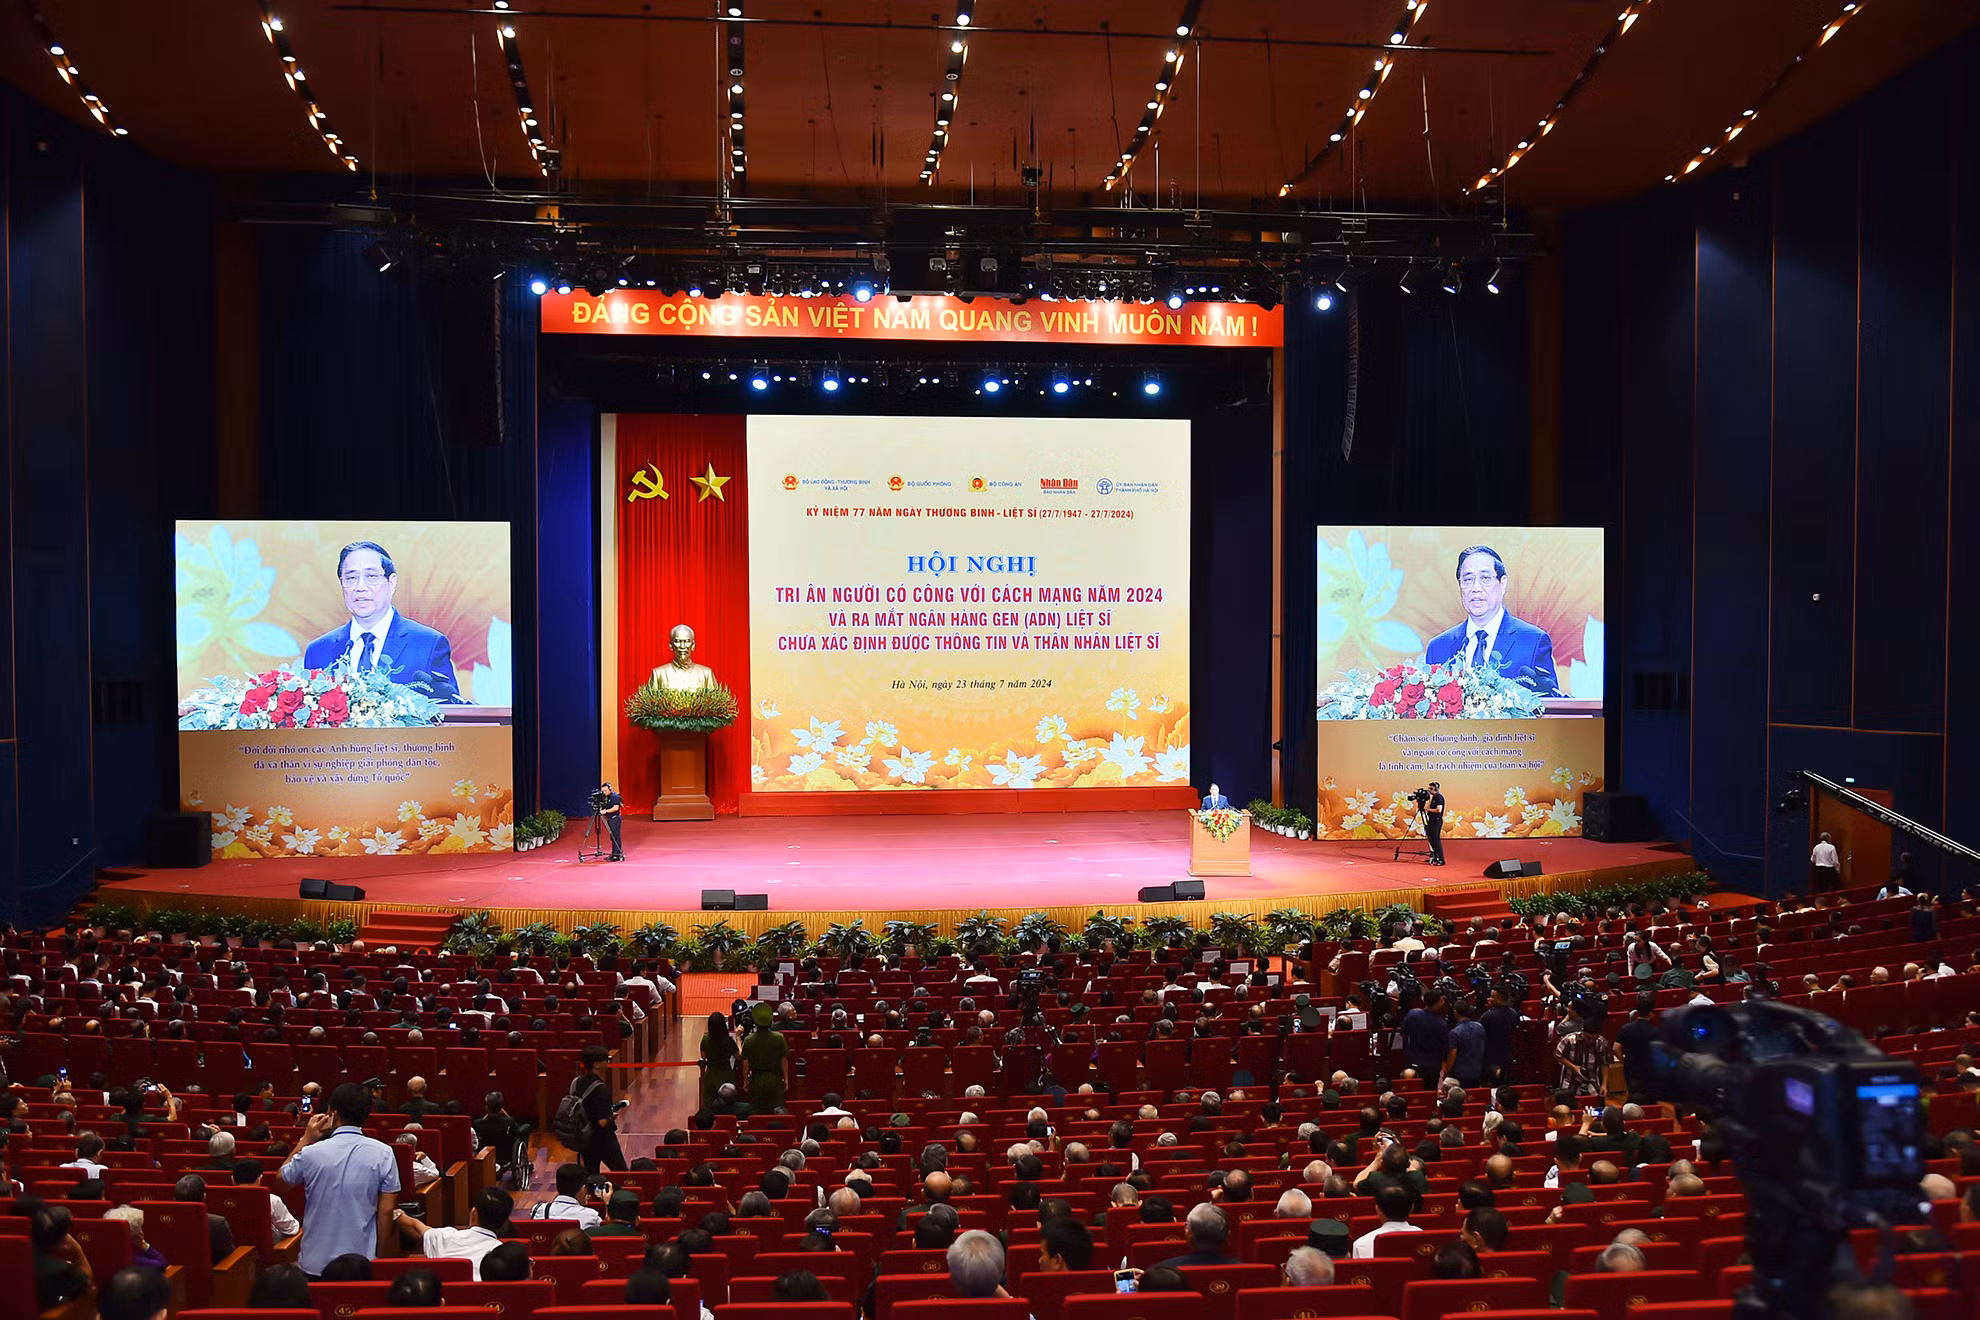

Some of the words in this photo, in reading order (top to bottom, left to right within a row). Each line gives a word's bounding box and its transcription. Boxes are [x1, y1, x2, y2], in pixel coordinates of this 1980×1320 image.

[659, 298, 739, 330] CỘNG
[746, 298, 799, 327] SẢN
[808, 302, 865, 334] VIỆT
[873, 307, 930, 330] NAM
[939, 309, 1033, 334] QUANG
[1043, 311, 1099, 334] VINH
[1108, 308, 1182, 335] MUÔN
[1040, 478, 1060, 488] Nhân
[1063, 478, 1078, 488] Dân
[806, 505, 819, 517] KỶ
[822, 506, 849, 519] NIỆM
[853, 508, 865, 517] 77
[869, 506, 892, 517] NĂM
[896, 506, 922, 517] NGÀY
[926, 507, 967, 517] THƯƠNG
[970, 509, 995, 518] BINH
[1003, 507, 1024, 519] LIỆT
[1027, 507, 1037, 518] SĨ
[1039, 510, 1082, 520] (27/7/1947
[1091, 510, 1134, 520] 27/7/2024)
[907, 551, 958, 577] HỘI
[966, 555, 1037, 577] NGHỊ
[776, 587, 800, 603] TRI
[806, 584, 826, 603] ÂN
[832, 584, 880, 603] NGƯỜI
[886, 584, 907, 603] CÓ
[913, 584, 954, 603] CÔNG
[960, 584, 985, 603] VỚI
[992, 584, 1032, 603] CÁCH
[1038, 587, 1082, 606] MẠNG
[1088, 584, 1120, 603] NĂM
[1126, 587, 1163, 603] 2024
[829, 609, 847, 626] VÀ
[852, 612, 870, 626] RA
[875, 607, 904, 626] MẮT
[909, 609, 946, 626] NGÂN
[951, 609, 988, 626] HÀNG
[992, 612, 1019, 626] GEN
[1024, 612, 1061, 629] (ADN)
[1066, 609, 1094, 629] LIỆT
[1098, 609, 1112, 626] SĨ
[778, 634, 816, 650] CHƯA
[821, 633, 848, 650] XÁC
[853, 636, 887, 653] ĐỊNH
[891, 634, 930, 653] ĐƯỢC
[934, 633, 980, 650] THÔNG
[986, 636, 1007, 650] TIN
[1012, 633, 1029, 650] VÀ
[1034, 633, 1069, 650] THÂN
[1074, 633, 1110, 650] NHÂN
[1115, 632, 1142, 652] LIỆT
[1147, 633, 1160, 649] SĨ
[892, 680, 906, 689] Hà
[909, 680, 928, 691] Nội,
[932, 680, 953, 691] ngày
[956, 680, 967, 689] 23
[970, 680, 996, 690] tháng
[999, 680, 1005, 688] 7
[1008, 680, 1027, 688] năm
[1030, 679, 1052, 688] 2024
